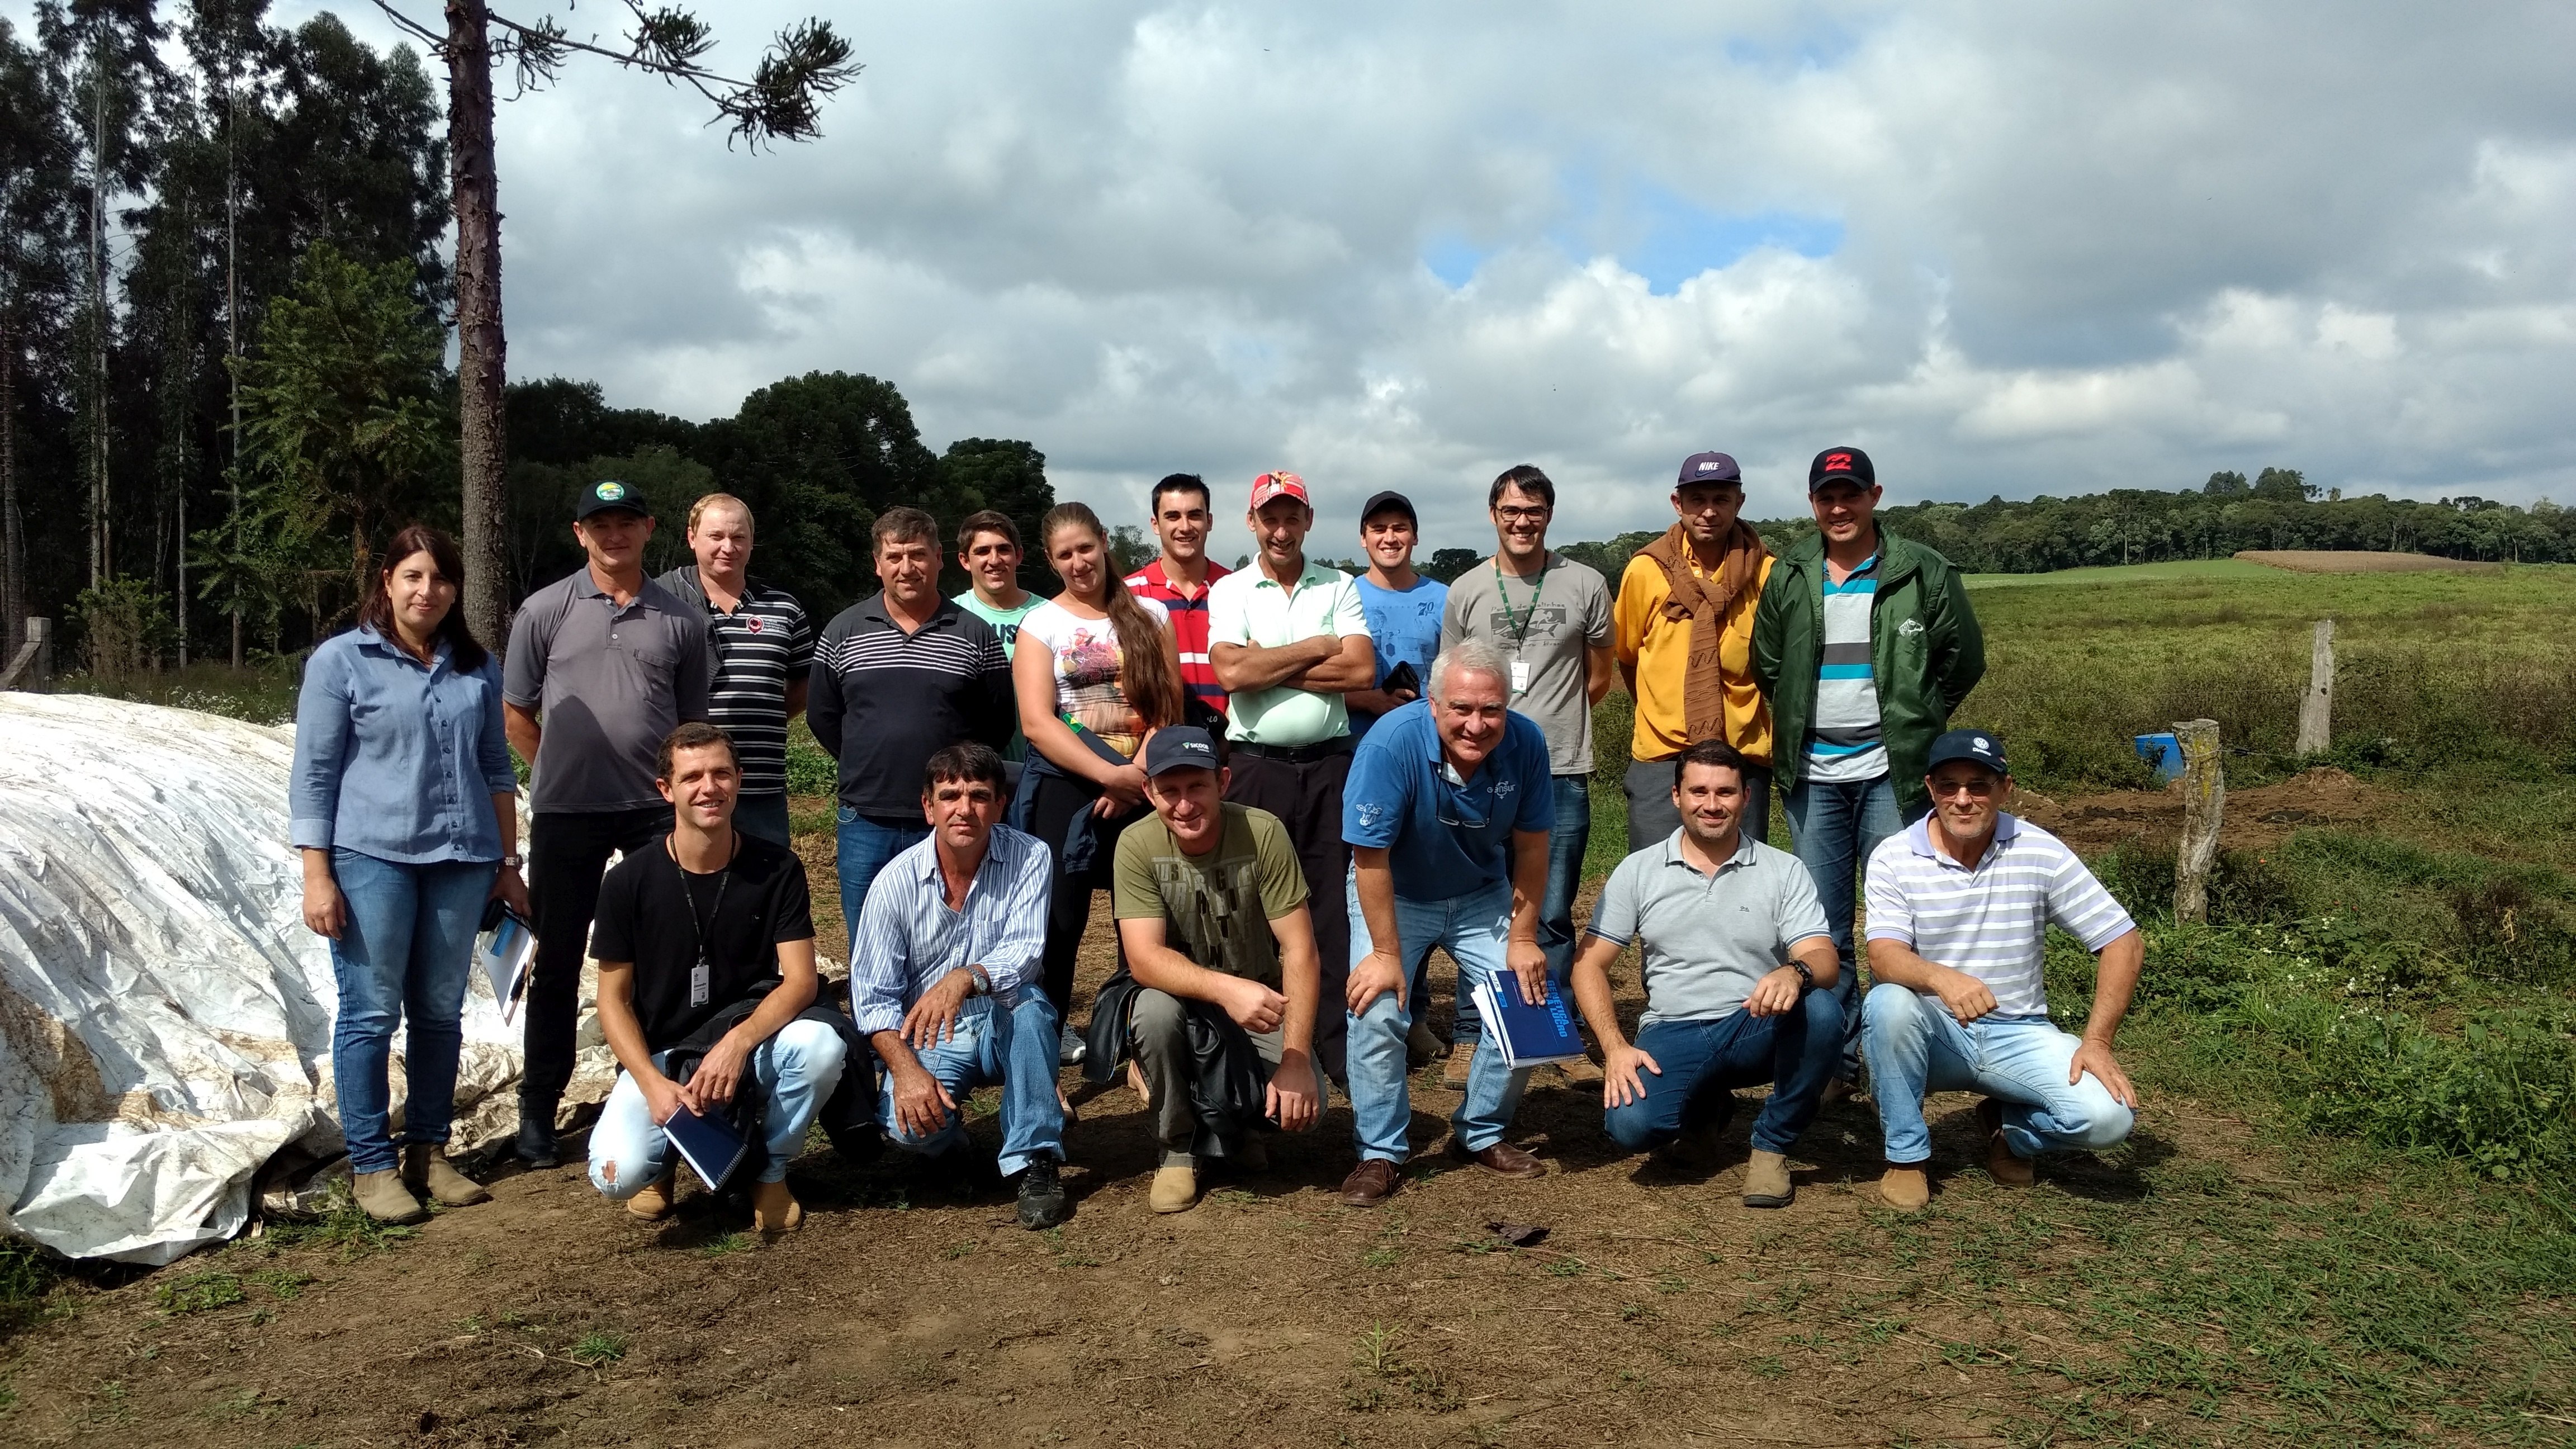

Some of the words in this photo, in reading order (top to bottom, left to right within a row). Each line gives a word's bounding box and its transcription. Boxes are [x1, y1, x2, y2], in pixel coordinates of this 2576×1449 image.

[1698, 462, 1720, 471] NIKE
[1418, 602, 1434, 615] 70
[1547, 980, 1570, 1025] GENÉTICA
[1550, 1008, 1568, 1038] LUCRO
